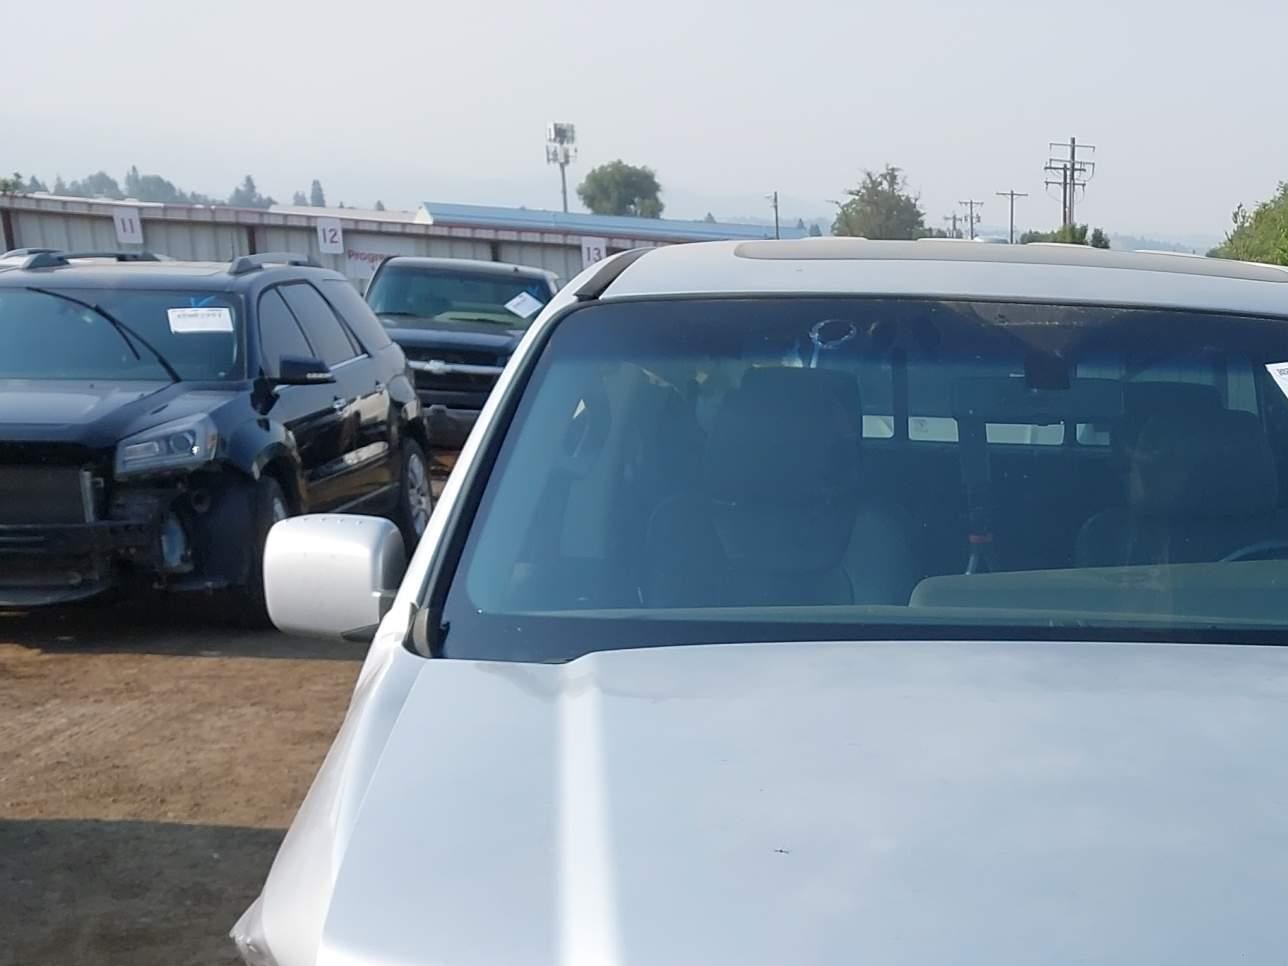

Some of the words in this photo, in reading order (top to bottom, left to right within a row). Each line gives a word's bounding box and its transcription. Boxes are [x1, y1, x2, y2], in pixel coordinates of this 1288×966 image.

[120, 218, 135, 234] 11
[322, 227, 339, 244] 12
[586, 246, 602, 263] 13
